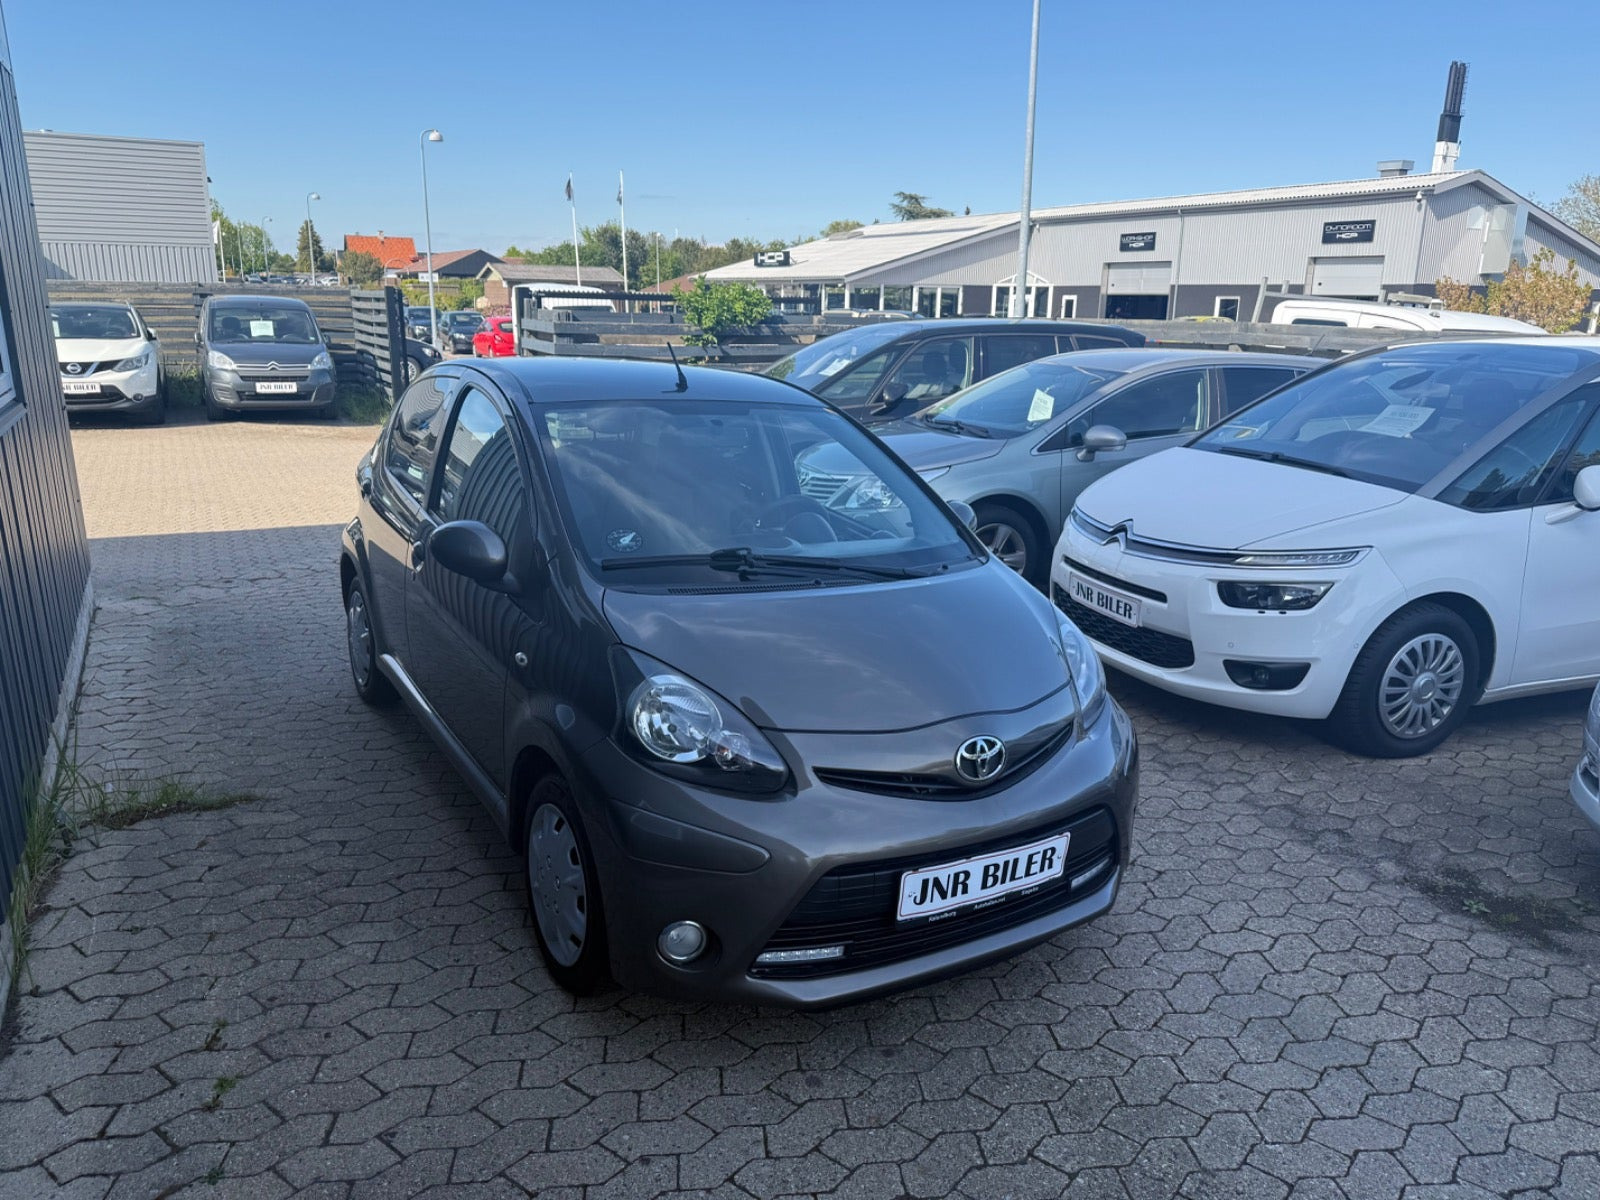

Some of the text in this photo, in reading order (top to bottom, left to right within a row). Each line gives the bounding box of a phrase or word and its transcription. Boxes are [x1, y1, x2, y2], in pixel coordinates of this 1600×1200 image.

[758, 252, 784, 263] HCP
[1075, 581, 1132, 619] JNR BILER
[913, 846, 1057, 906] JNR BILER
